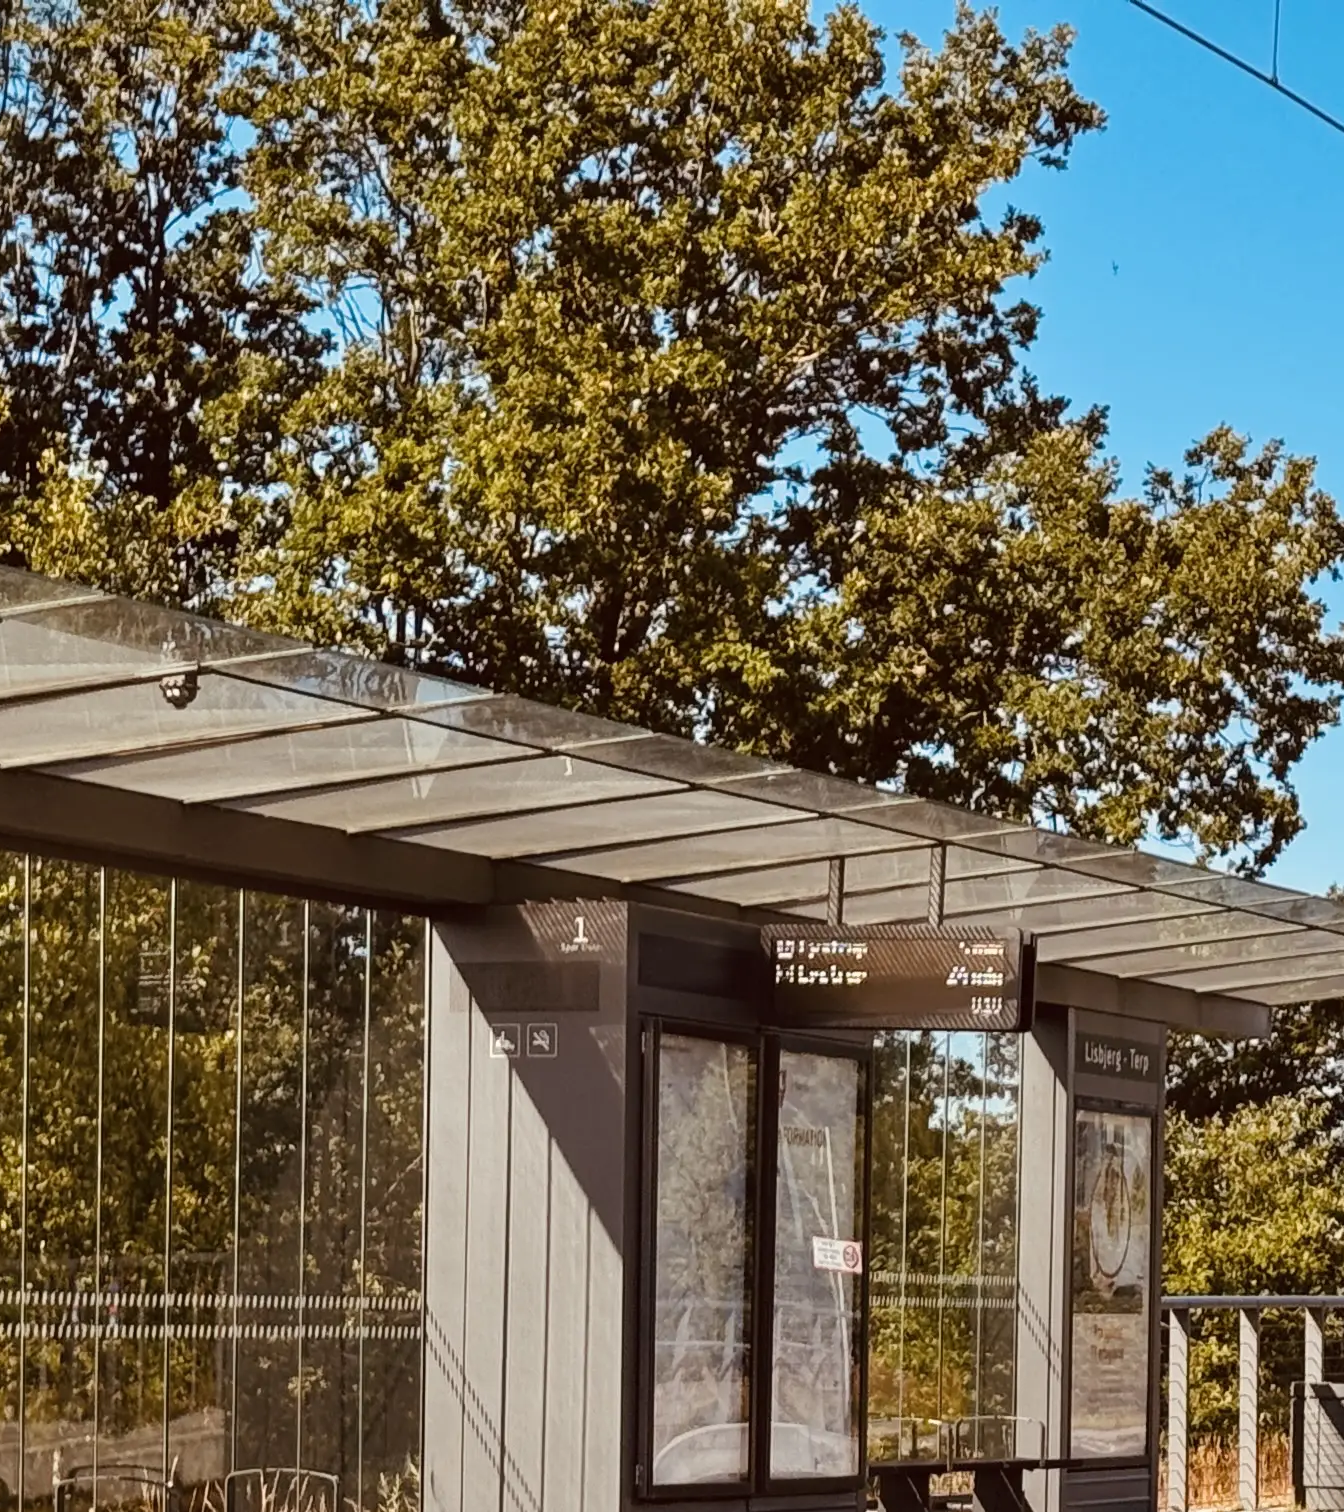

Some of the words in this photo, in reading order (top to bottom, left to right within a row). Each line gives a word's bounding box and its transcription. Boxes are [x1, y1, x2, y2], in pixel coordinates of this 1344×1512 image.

[572, 915, 589, 944] 1
[1084, 1040, 1122, 1072] Lisbjerg
[1129, 1048, 1150, 1077] Terp
